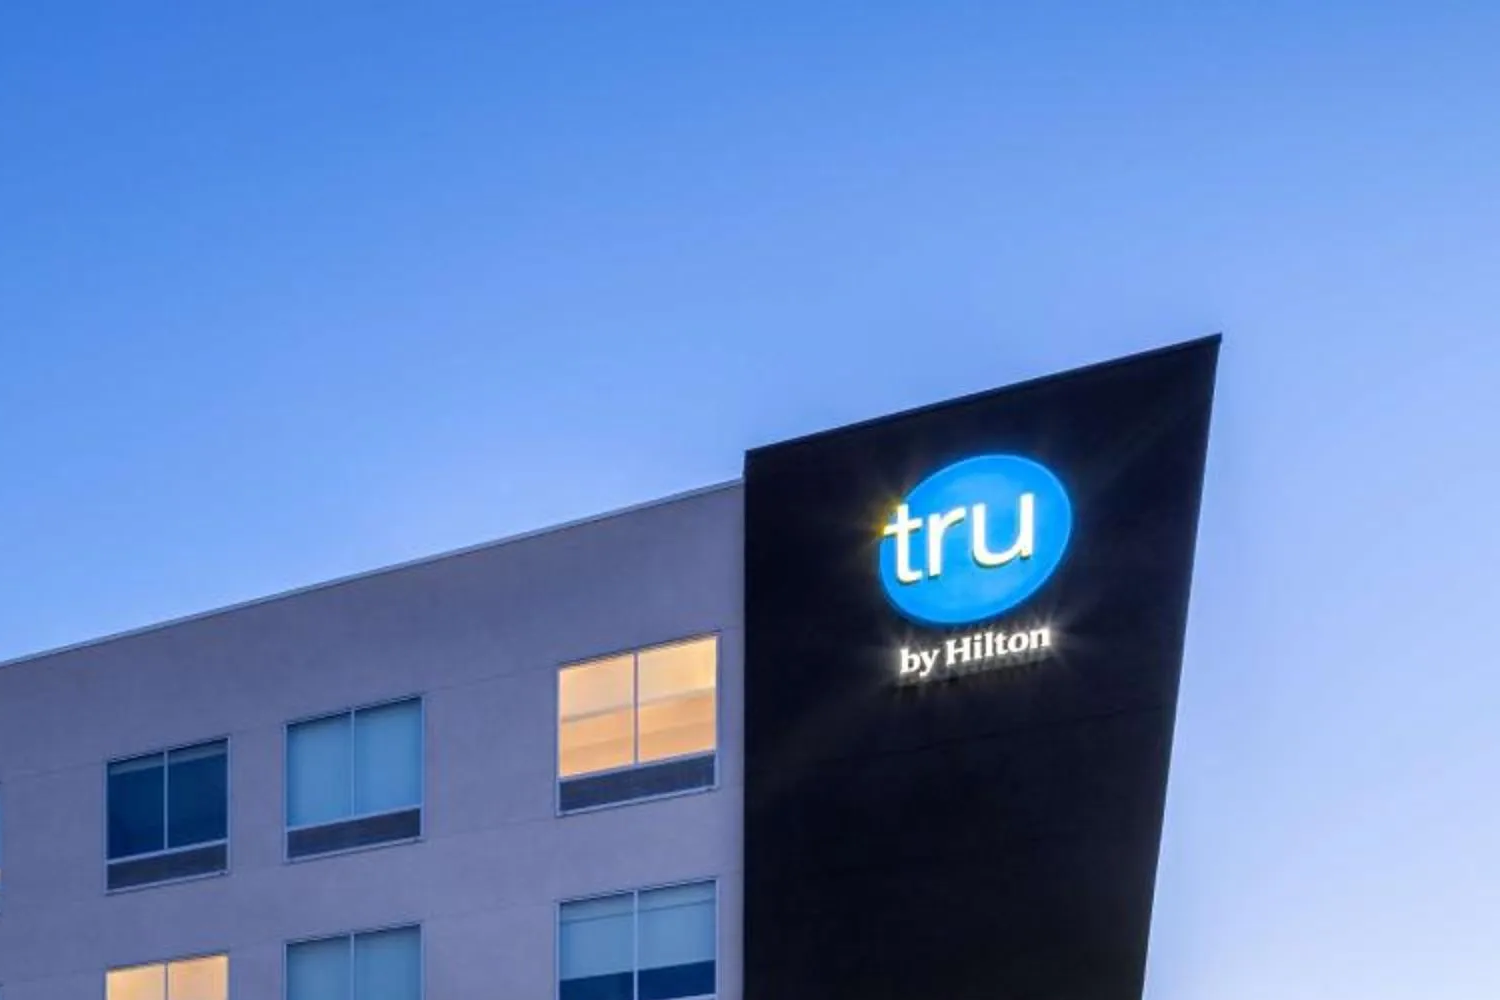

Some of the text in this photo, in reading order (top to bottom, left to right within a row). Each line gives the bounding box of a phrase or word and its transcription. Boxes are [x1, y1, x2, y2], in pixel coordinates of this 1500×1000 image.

[883, 492, 1035, 584] tru
[900, 626, 1051, 677] by Hilton
